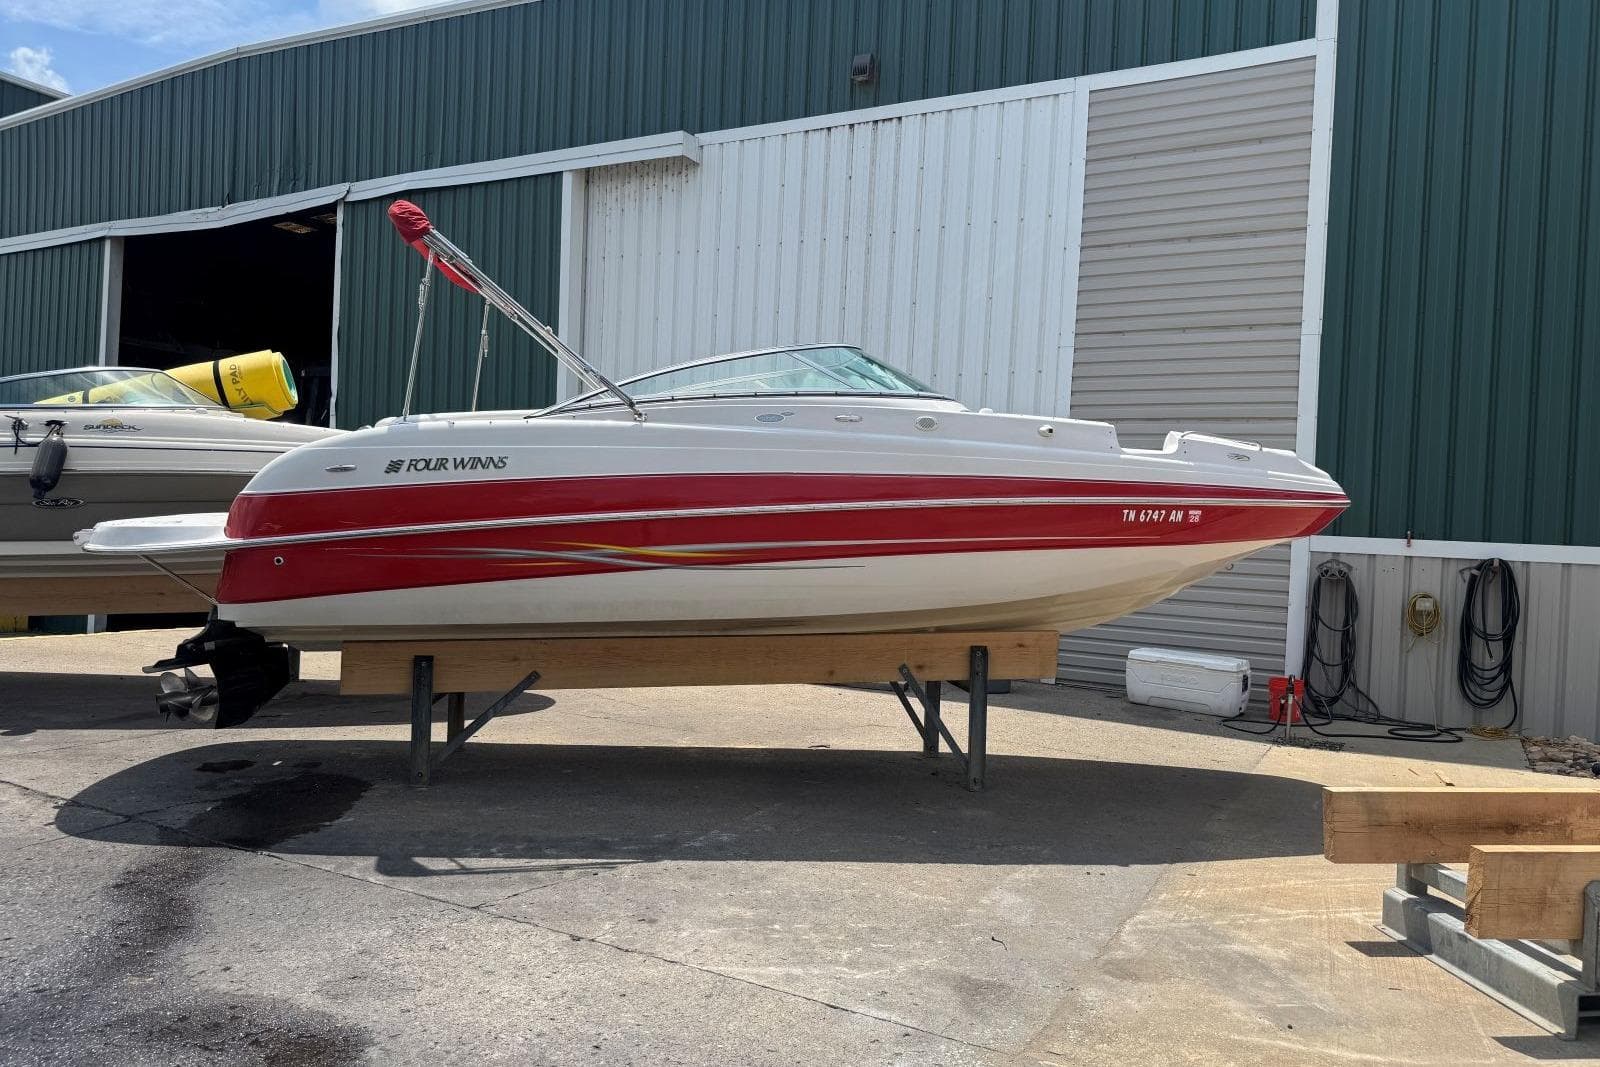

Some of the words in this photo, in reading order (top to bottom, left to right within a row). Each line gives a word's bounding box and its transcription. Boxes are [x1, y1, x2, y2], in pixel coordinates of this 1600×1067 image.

[230, 364, 240, 384] PAD
[406, 457, 448, 472] FOUR
[453, 456, 508, 470] WINNS
[1122, 509, 1136, 522] TN
[1139, 509, 1166, 522] 6747
[1168, 510, 1184, 522] AN
